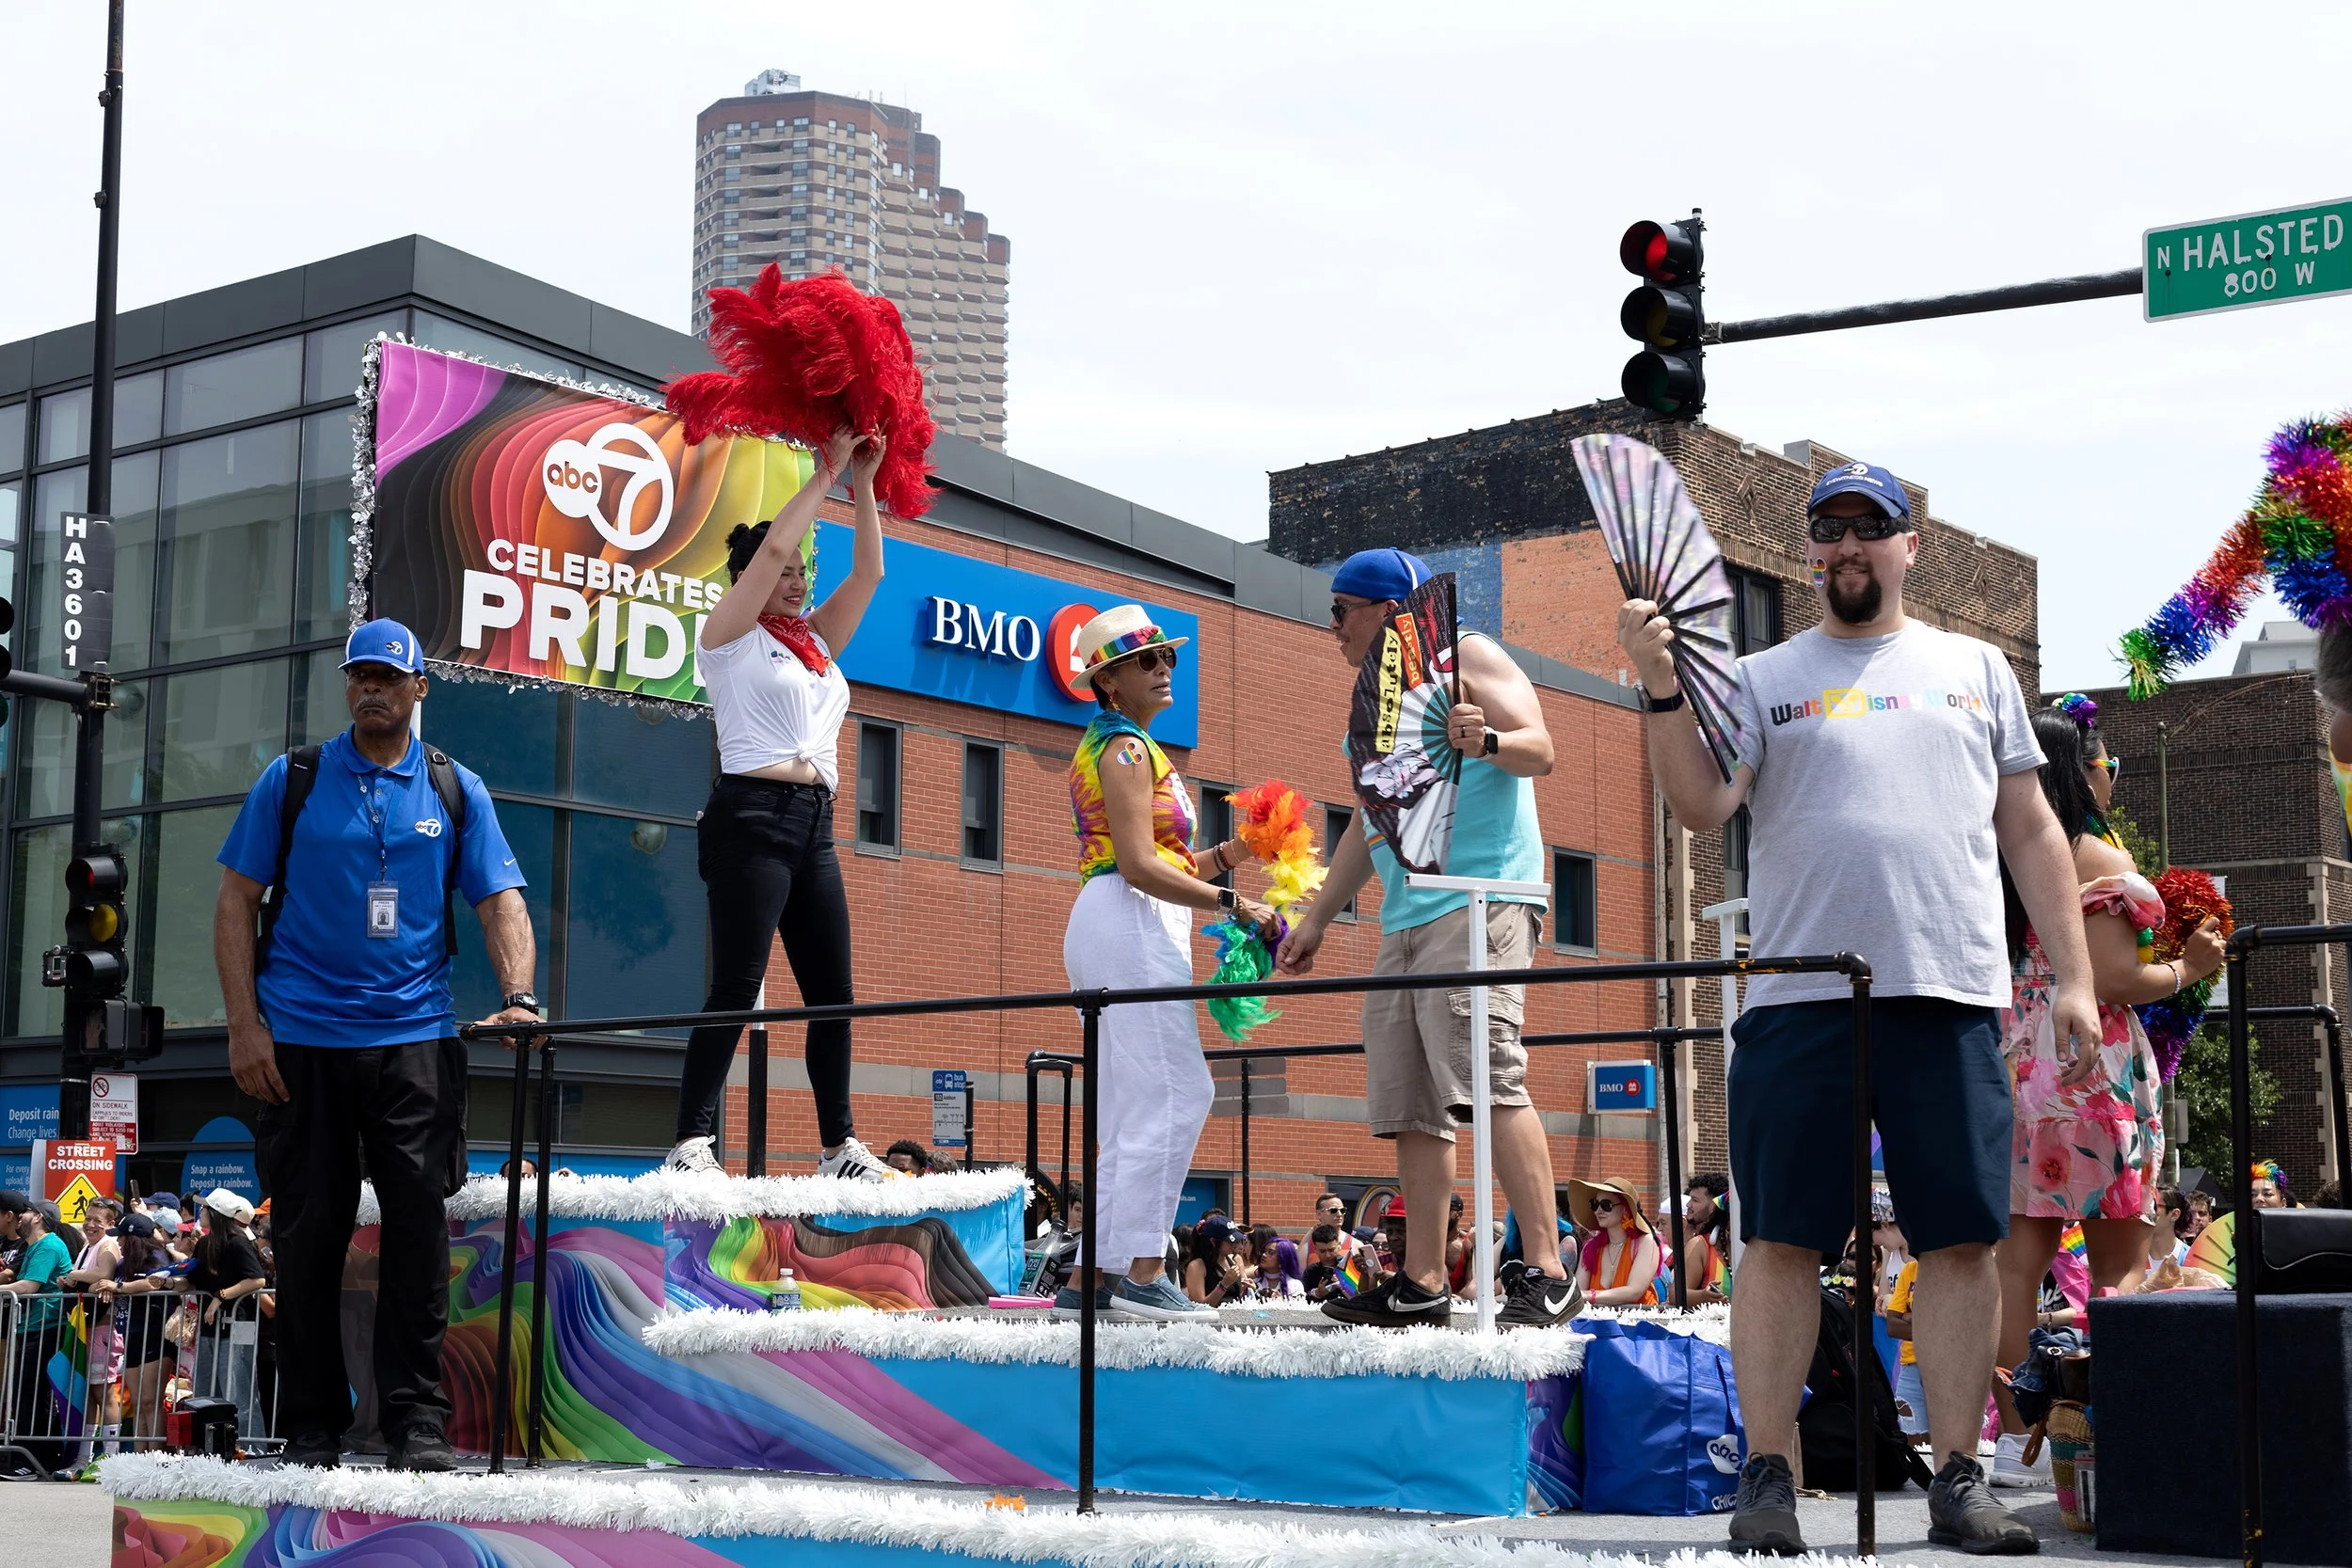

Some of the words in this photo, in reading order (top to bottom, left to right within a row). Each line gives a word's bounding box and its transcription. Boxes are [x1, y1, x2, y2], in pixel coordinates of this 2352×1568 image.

[2157, 245, 2170, 269] N
[2183, 214, 2344, 271] HALSTED
[2224, 267, 2277, 298] 800
[2295, 261, 2315, 286] W
[547, 461, 598, 494] abc
[486, 538, 724, 611] CELEBRATES
[64, 515, 87, 667] HA3601
[932, 595, 1041, 661] BMO
[1381, 634, 1398, 749] absolutely
[1770, 699, 1823, 727] Walt
[1599, 1084, 1624, 1093] BMO
[8, 1107, 40, 1124] Deposit
[8, 1126, 35, 1141] Change
[56, 1146, 106, 1157] STREET
[48, 1159, 113, 1171] CROSSING
[191, 1164, 207, 1176] Snap
[215, 1163, 245, 1174] rainbow.
[190, 1178, 216, 1190] Deposit
[223, 1177, 253, 1188] rainbow.
[1709, 1443, 1742, 1463] abc
